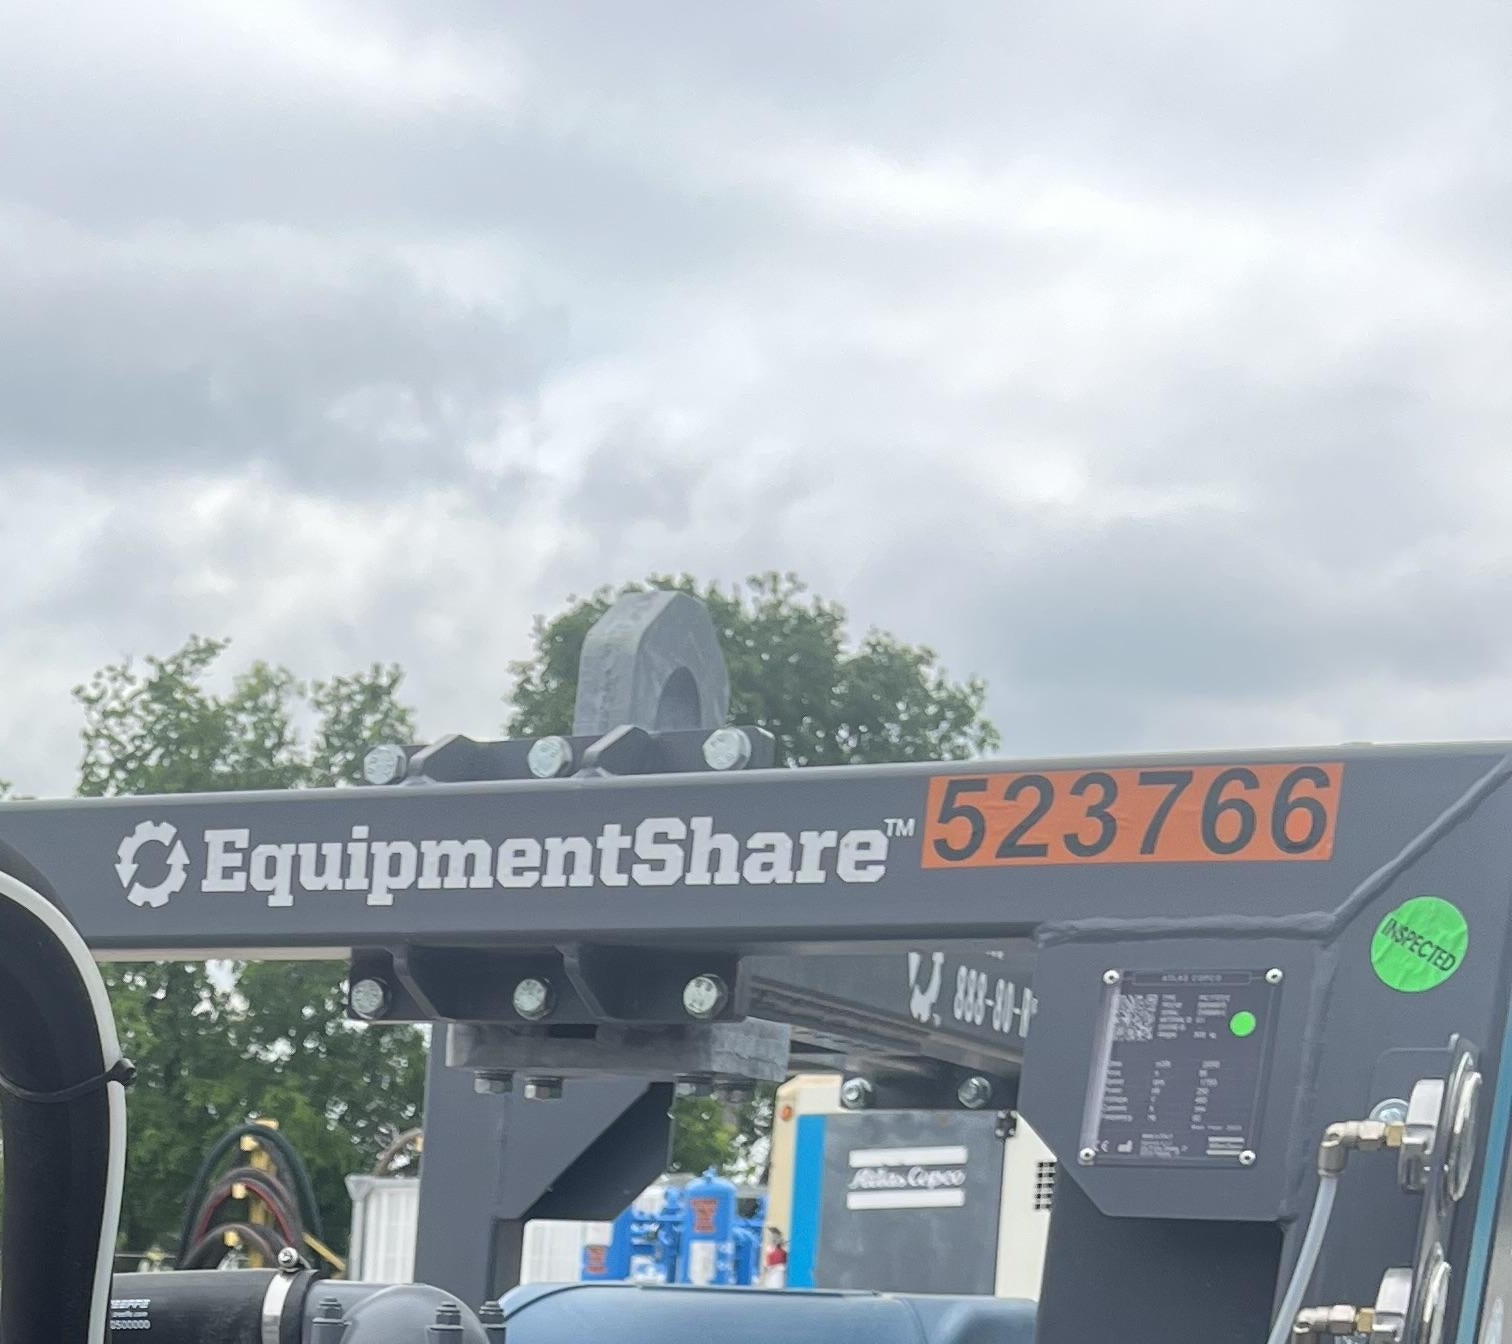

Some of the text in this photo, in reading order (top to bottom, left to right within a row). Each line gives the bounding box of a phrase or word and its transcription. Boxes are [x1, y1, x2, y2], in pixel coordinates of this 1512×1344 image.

[932, 766, 1331, 861] 523766
[201, 816, 888, 907] EquipmentShare
[1384, 918, 1456, 972] INSPECTED
